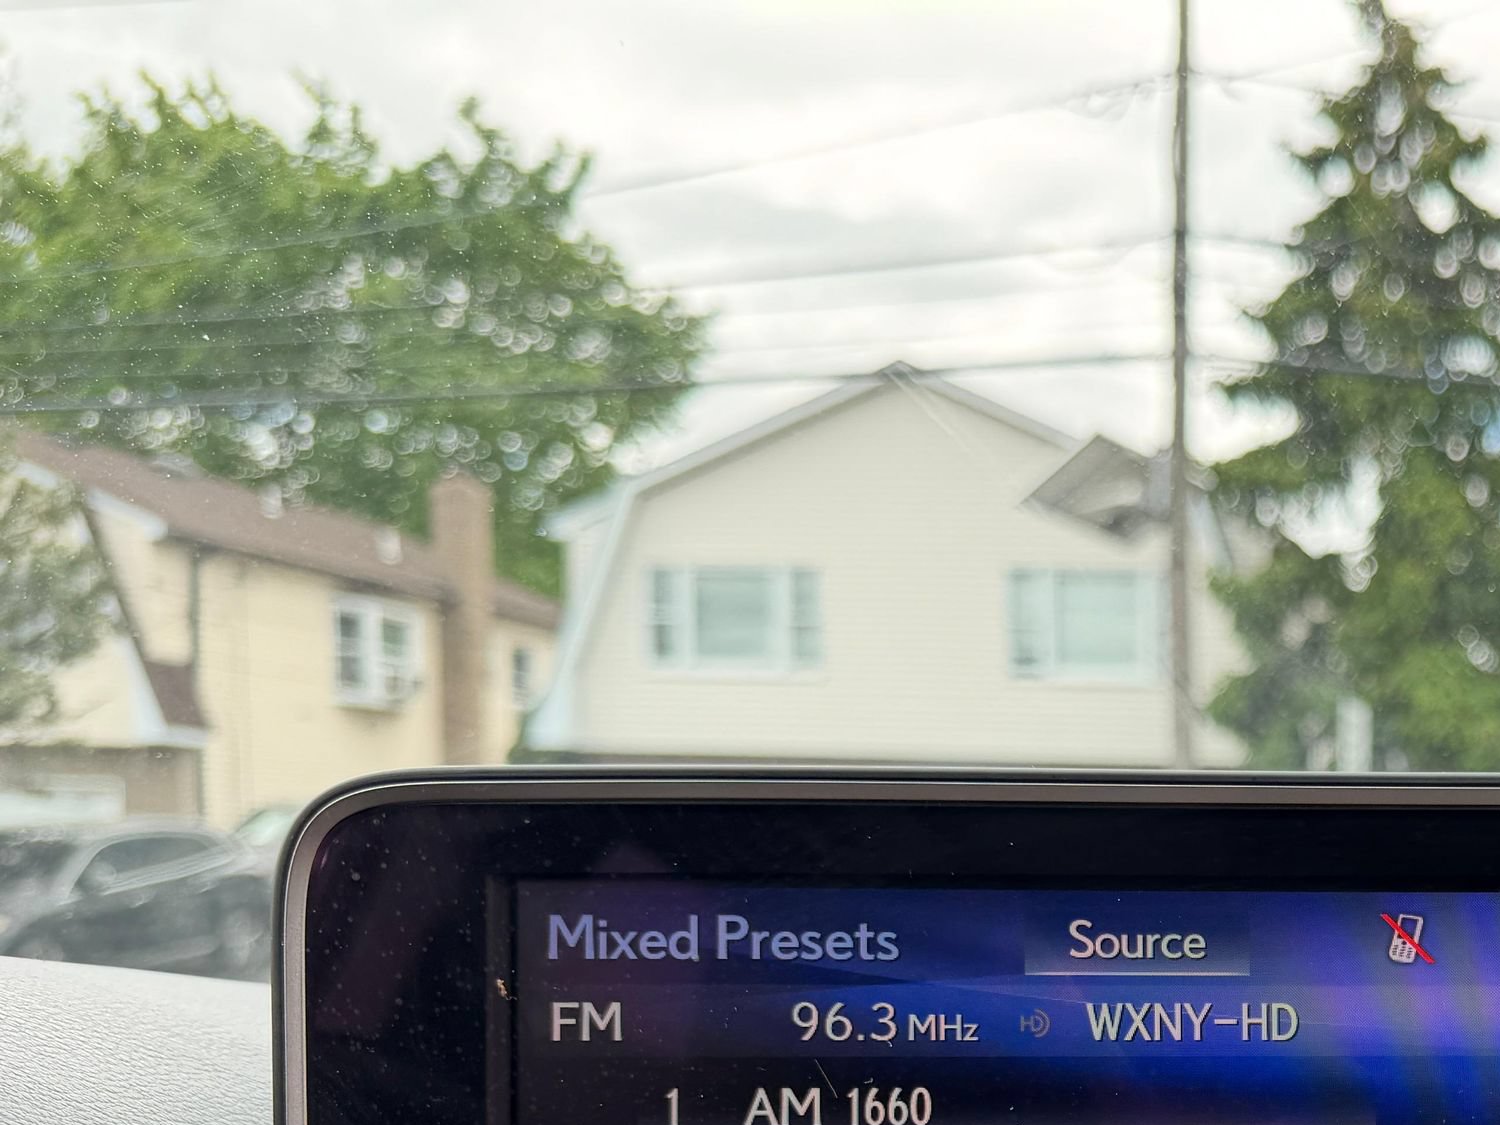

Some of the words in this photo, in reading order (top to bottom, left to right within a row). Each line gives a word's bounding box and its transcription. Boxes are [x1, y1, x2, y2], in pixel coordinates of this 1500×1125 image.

[547, 914, 699, 961] Mixed
[716, 914, 900, 961] Presets
[1069, 919, 1207, 960] Source
[551, 1001, 623, 1042] FM
[791, 1001, 898, 1042] 96.3
[908, 1013, 979, 1042] MHz
[1086, 1002, 1300, 1042] WXNY-HD
